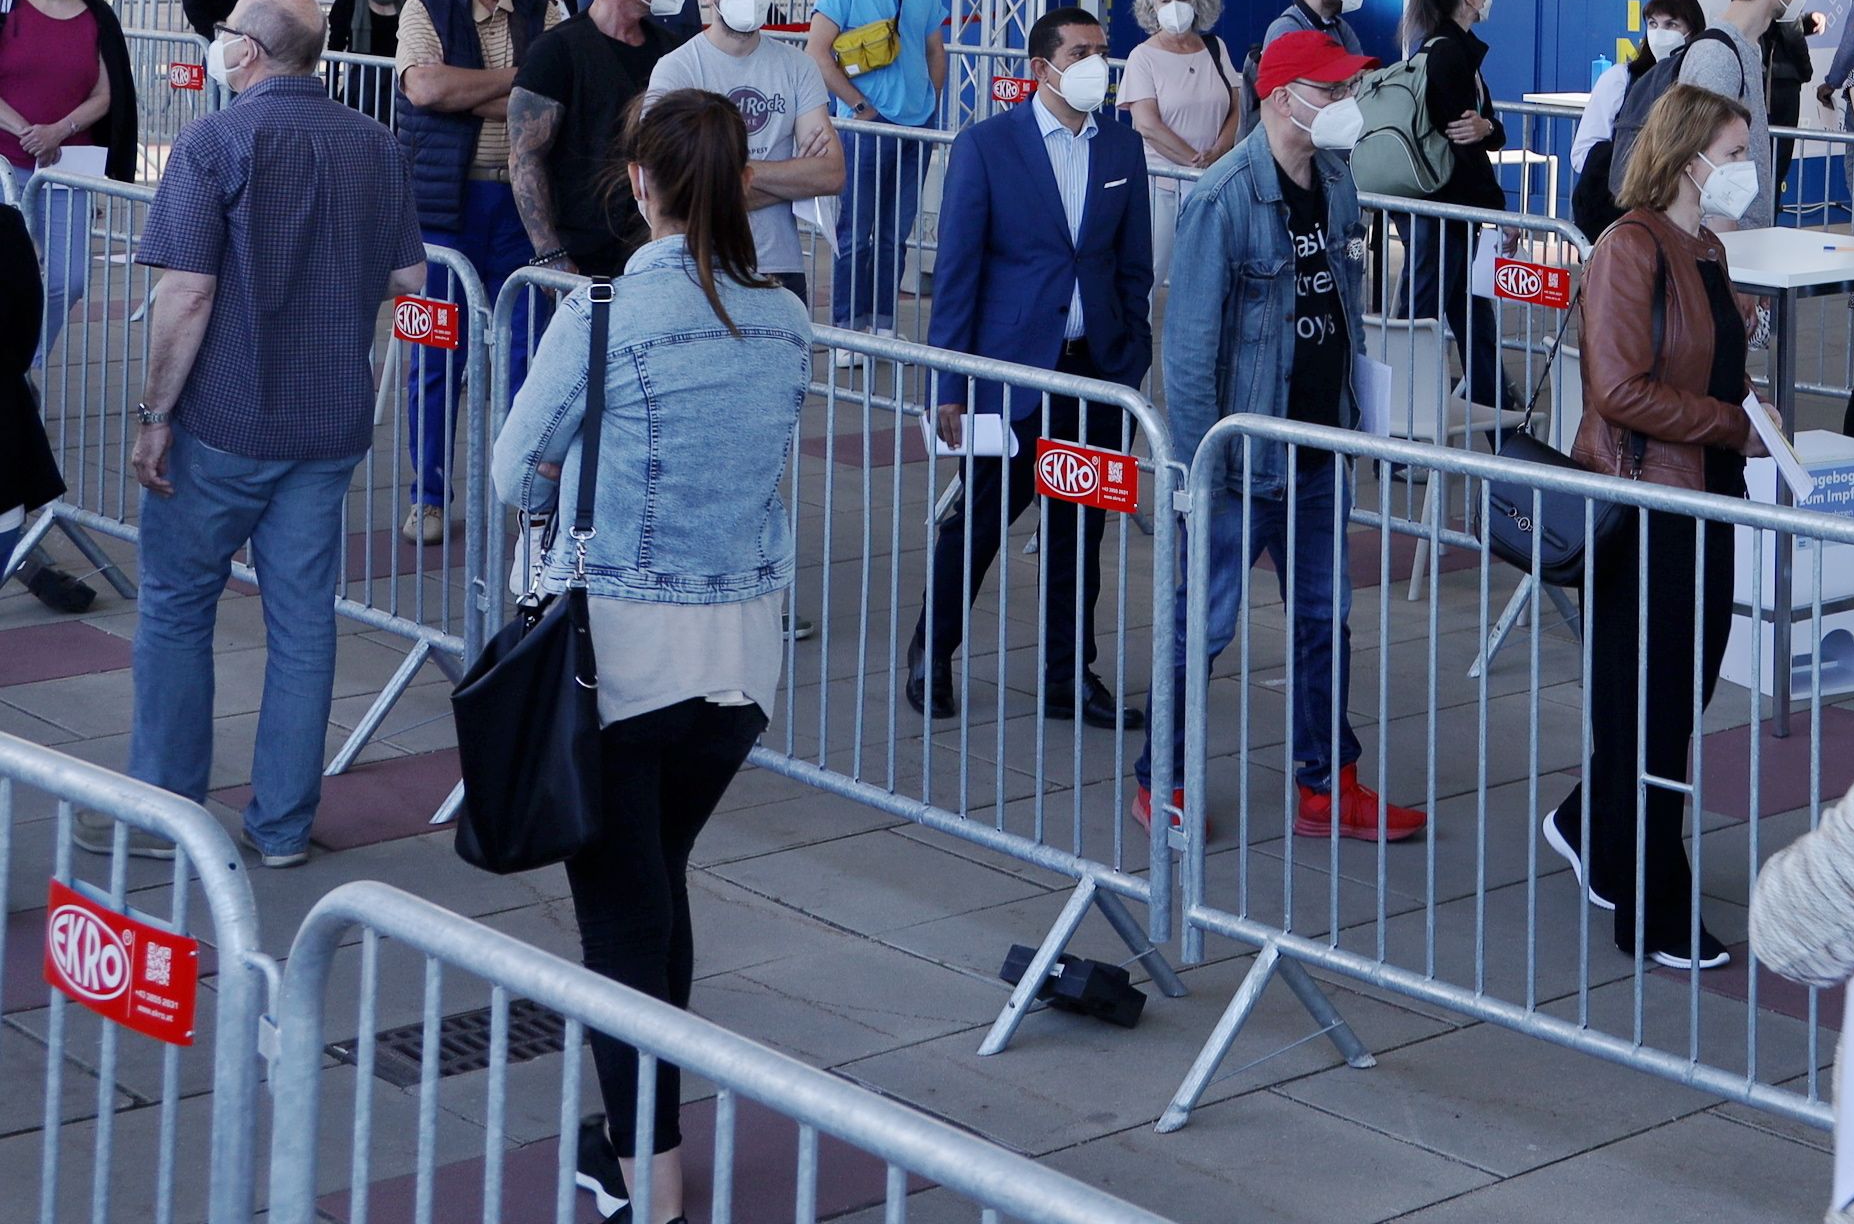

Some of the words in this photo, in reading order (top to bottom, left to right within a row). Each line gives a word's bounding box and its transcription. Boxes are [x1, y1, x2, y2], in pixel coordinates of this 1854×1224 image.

[993, 81, 1018, 98] EKRO
[746, 93, 786, 116] Rock
[1498, 267, 1539, 295] EKRO
[396, 304, 430, 335] EKRO
[1041, 453, 1094, 492] EKRO
[52, 913, 123, 991] EKRO
